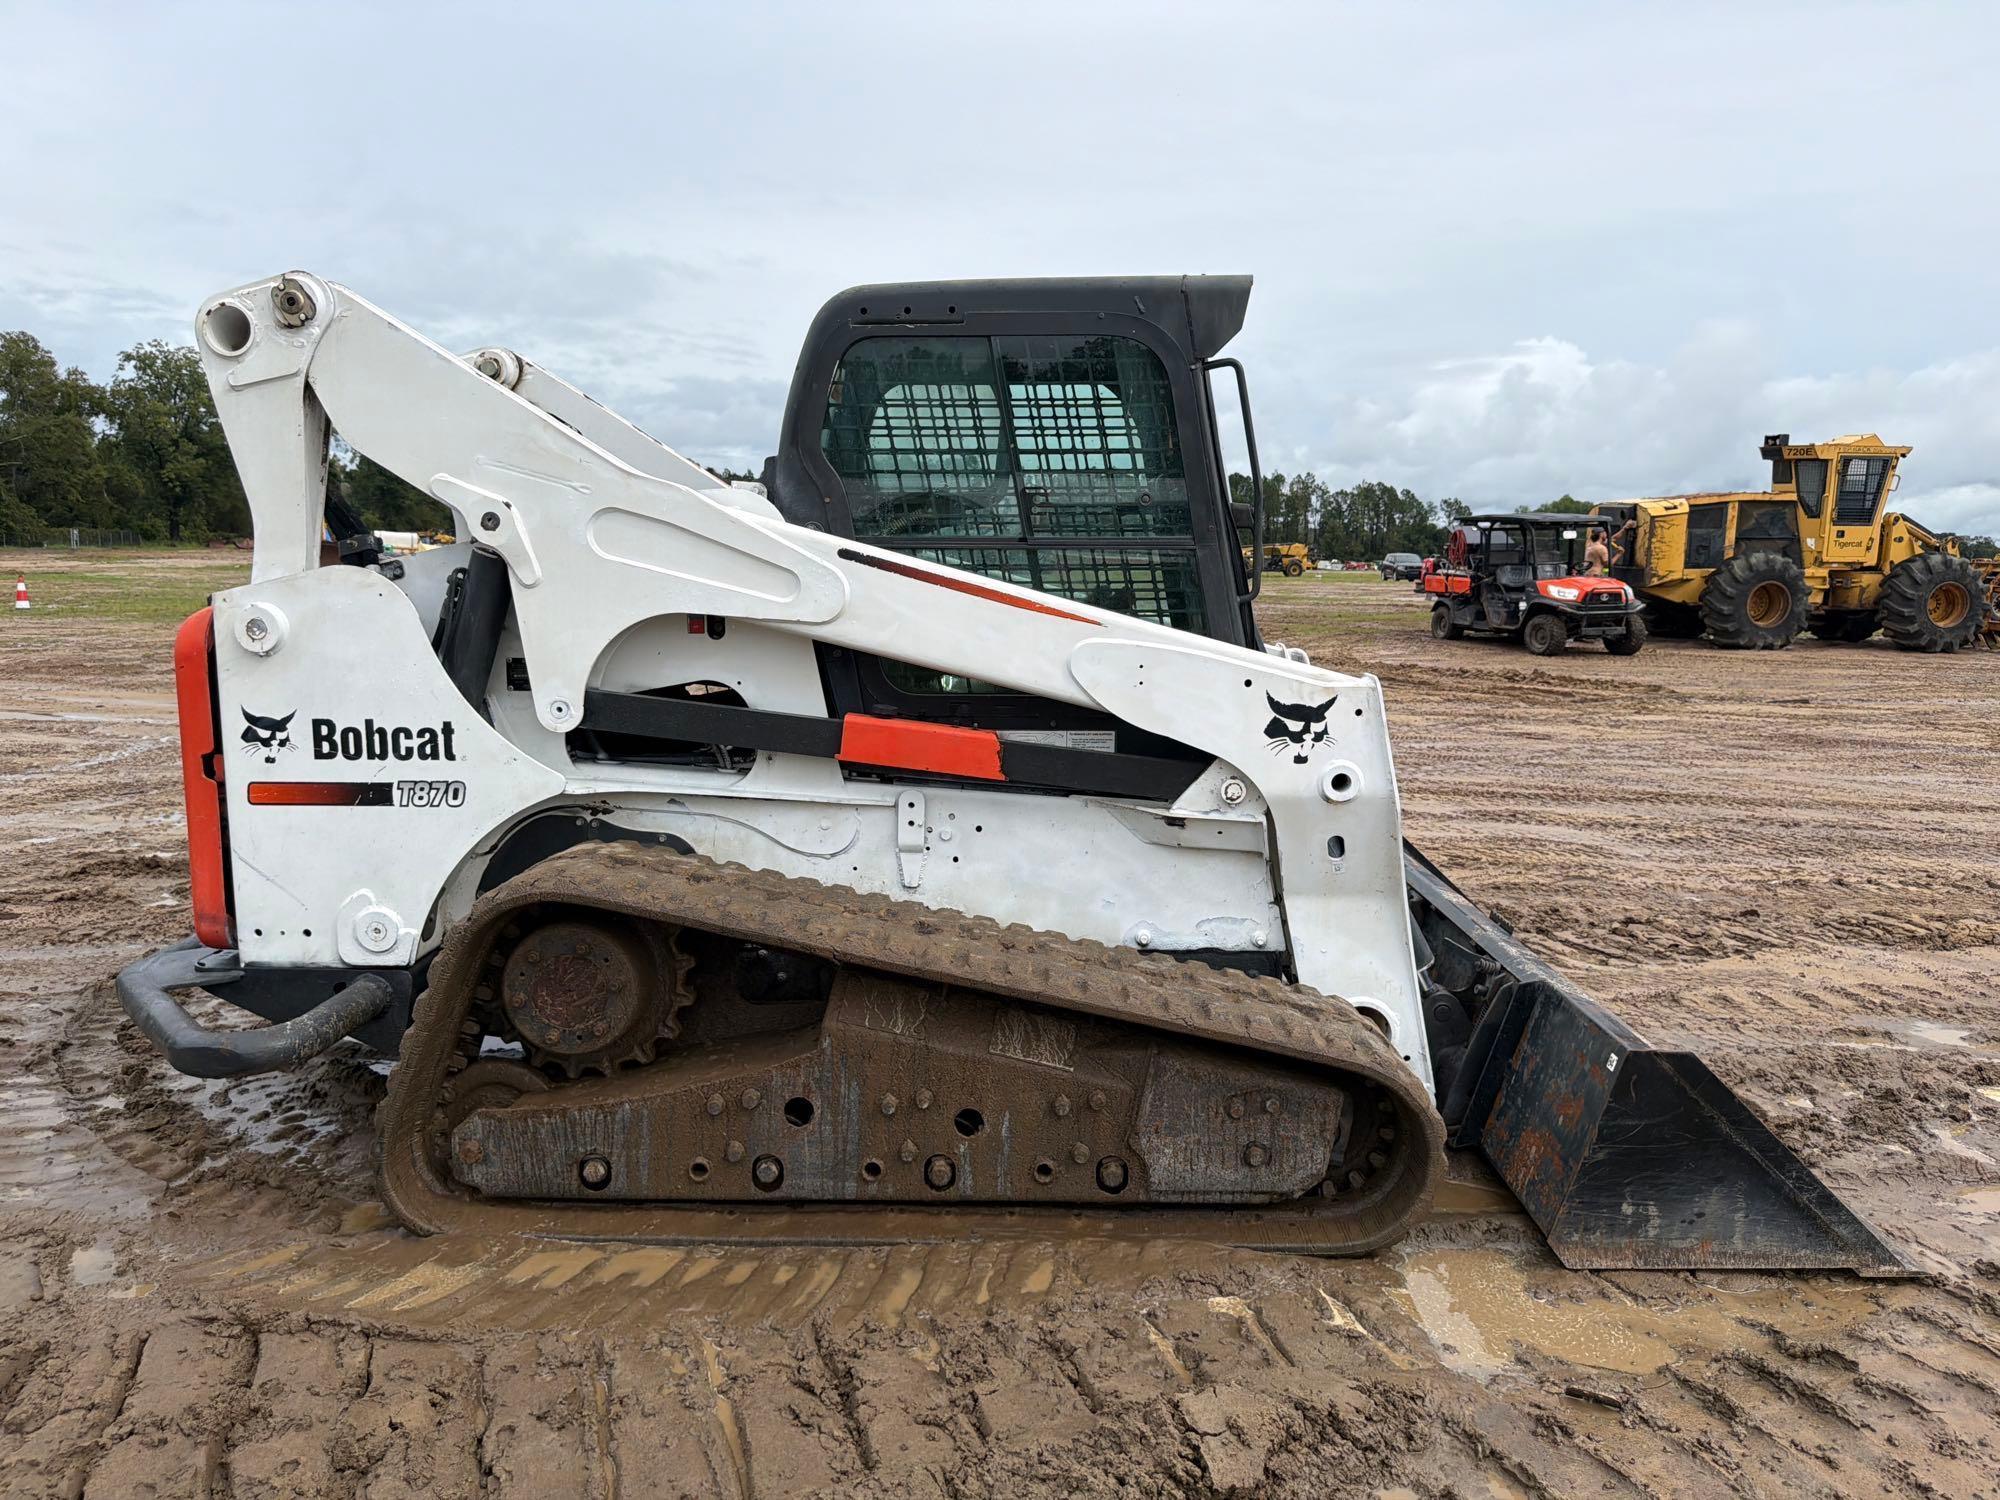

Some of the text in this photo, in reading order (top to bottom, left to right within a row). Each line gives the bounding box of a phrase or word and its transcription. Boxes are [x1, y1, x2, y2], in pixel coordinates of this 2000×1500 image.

[1786, 448, 1813, 456] 720E
[1833, 540, 1863, 549] Tigercat
[312, 718, 456, 761] Bobcat
[396, 781, 466, 807] T870
